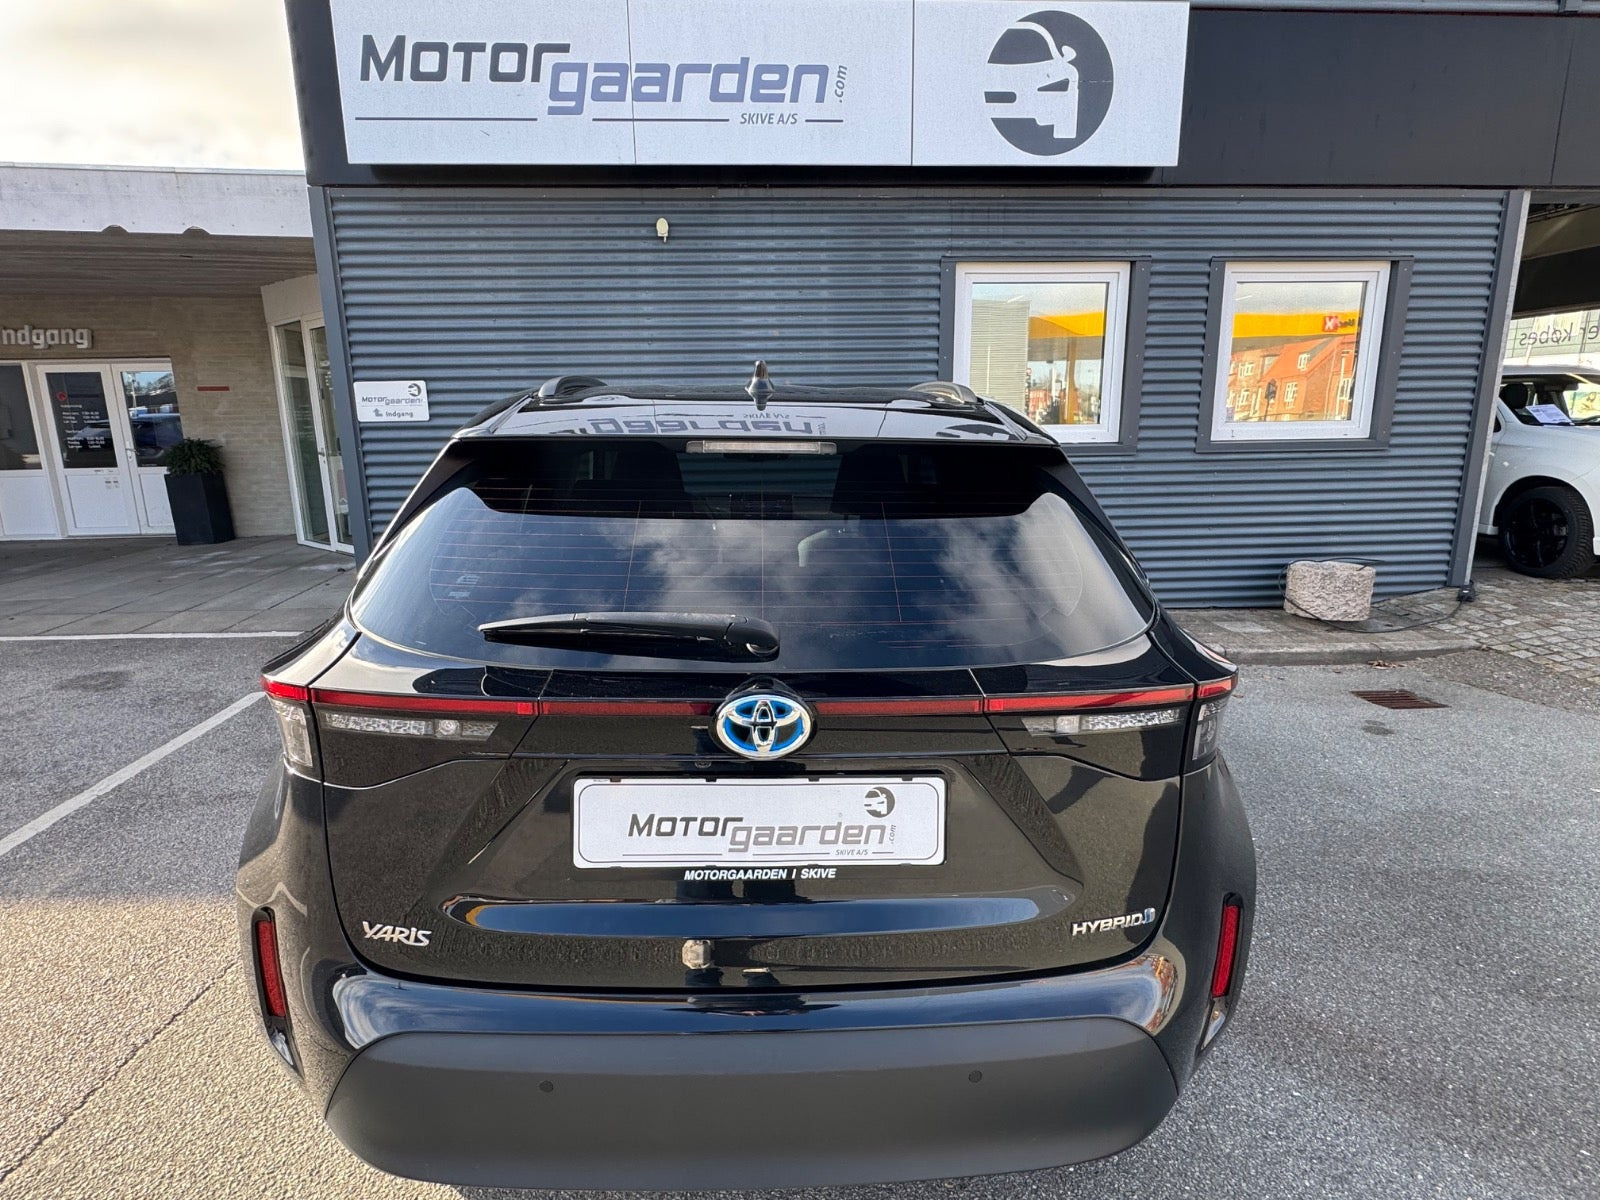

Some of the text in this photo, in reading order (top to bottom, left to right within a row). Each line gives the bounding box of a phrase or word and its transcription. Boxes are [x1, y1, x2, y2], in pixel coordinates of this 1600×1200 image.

[835, 64, 848, 103] .com
[740, 112, 798, 125] SKIVE A/S
[0, 324, 92, 349] ndgang
[385, 410, 414, 419] Indgang
[835, 848, 869, 856] SKIVE A/S
[683, 869, 788, 881] MOTORGAARDEN
[800, 868, 838, 879] SKIVE
[362, 920, 433, 947] YARIS
[1071, 912, 1144, 937] HYBRID
